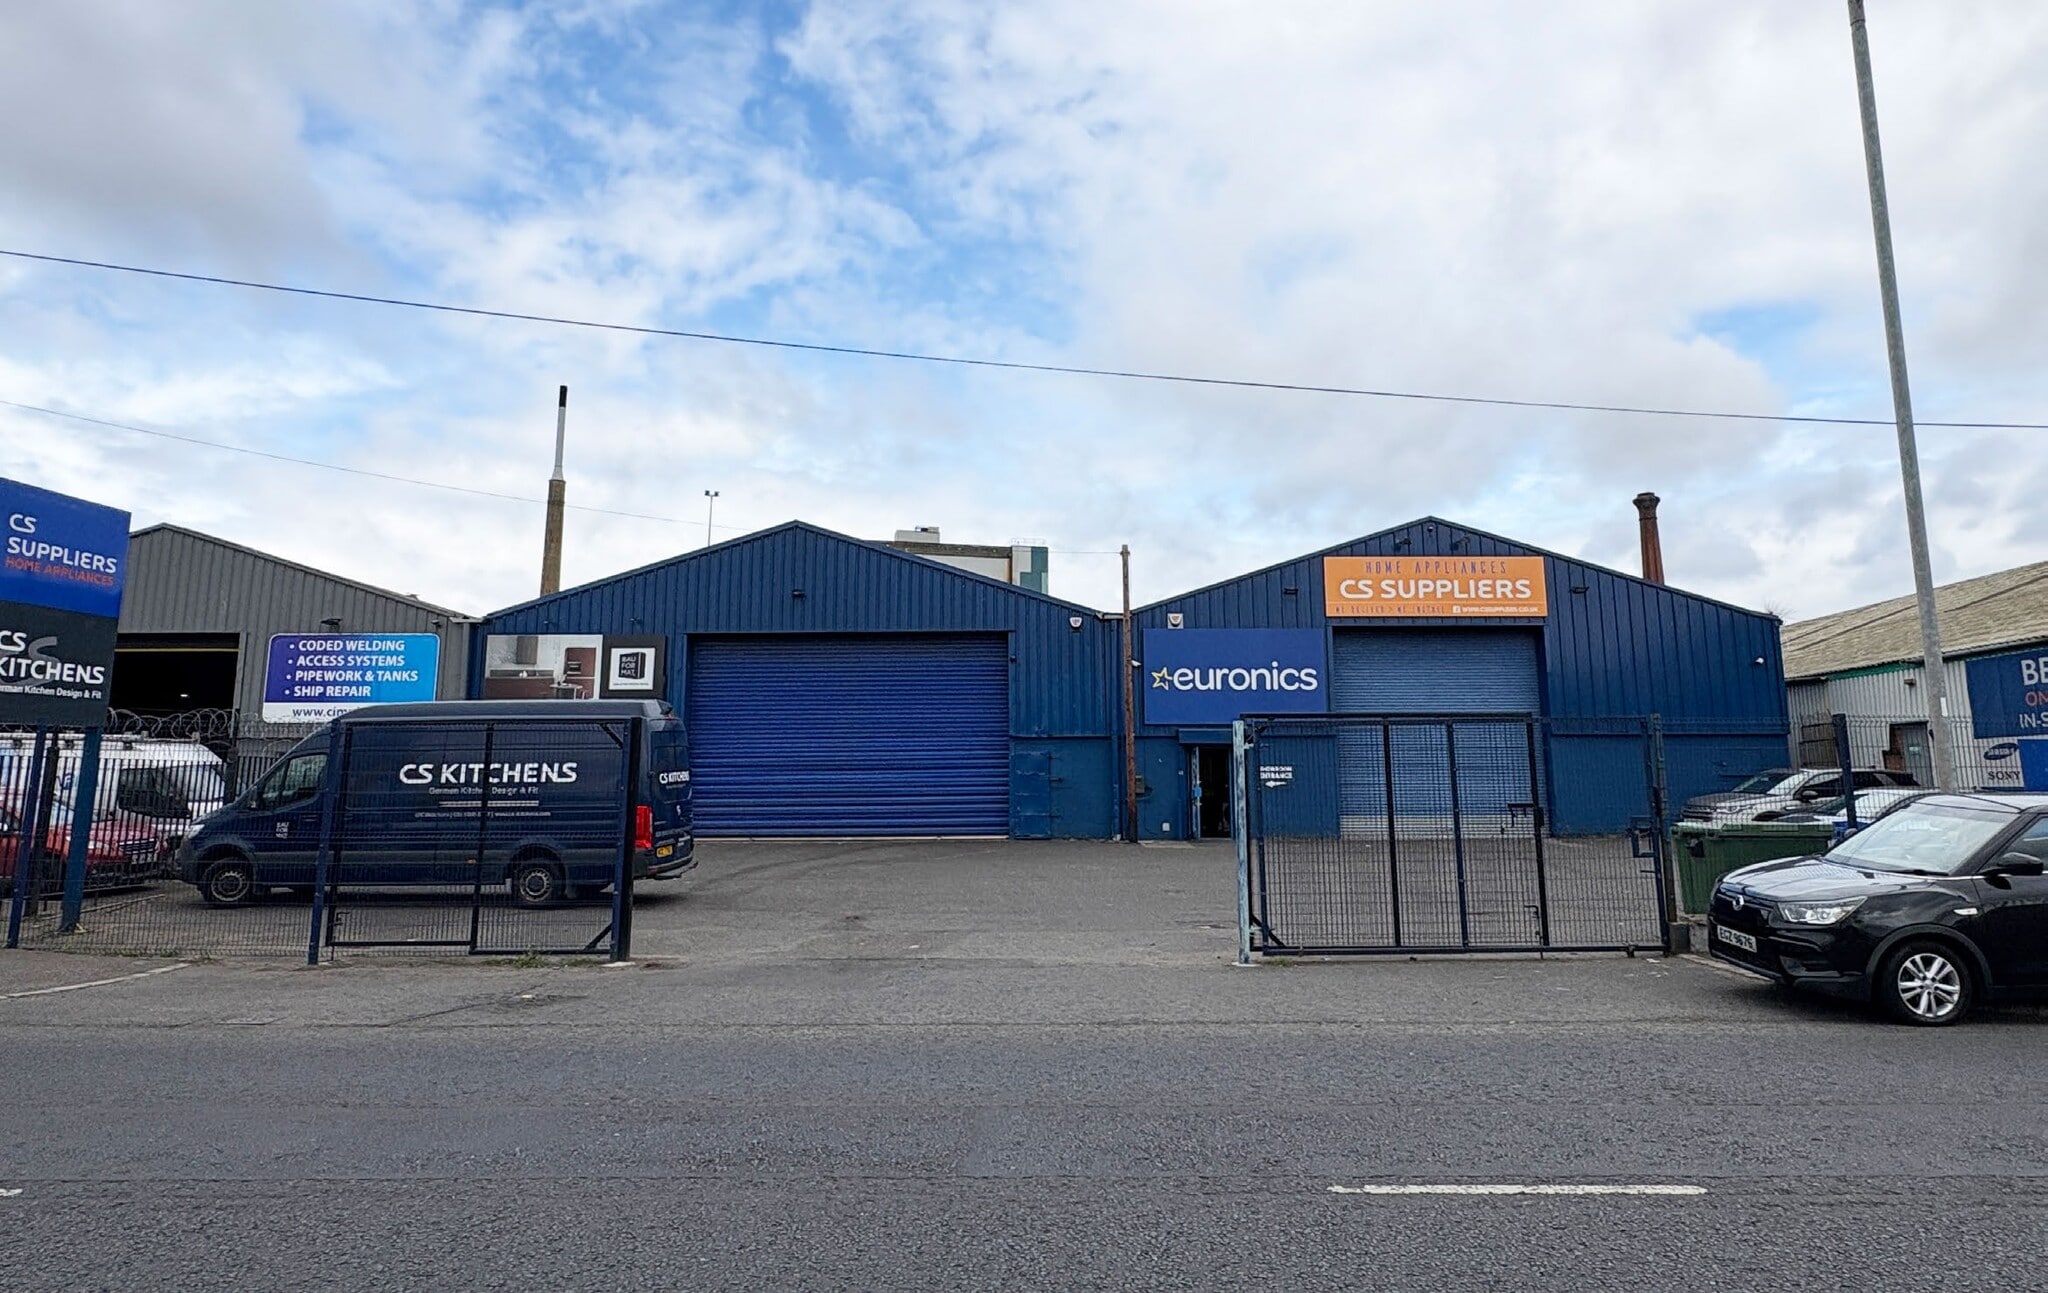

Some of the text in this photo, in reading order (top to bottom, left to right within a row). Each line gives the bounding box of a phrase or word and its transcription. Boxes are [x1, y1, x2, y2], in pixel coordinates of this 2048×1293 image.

[9, 513, 37, 534] CS
[7, 536, 117, 574] SUPPLIERS
[5, 557, 114, 586] HOME APPLIANCES
[1366, 560, 1506, 574] HOME APPLIANCES
[1339, 579, 1532, 599] CS SUPPLIERS
[0, 630, 27, 652] CS
[299, 640, 405, 651] CODED WELDING
[296, 655, 405, 667] ACCESS SYSTEMS
[0, 657, 105, 684] KITCHENS
[295, 671, 418, 682] PIPEWORK & TANKS
[1173, 661, 1318, 691] euronics
[24, 685, 55, 696] Kitchen
[56, 687, 82, 699] Design
[84, 690, 90, 699] &
[92, 691, 102, 699] Fit
[293, 686, 371, 697] SHIP REPAIR
[399, 762, 578, 785] CS KITCHENS
[659, 773, 669, 784] CS
[1988, 770, 2020, 781] SONY
